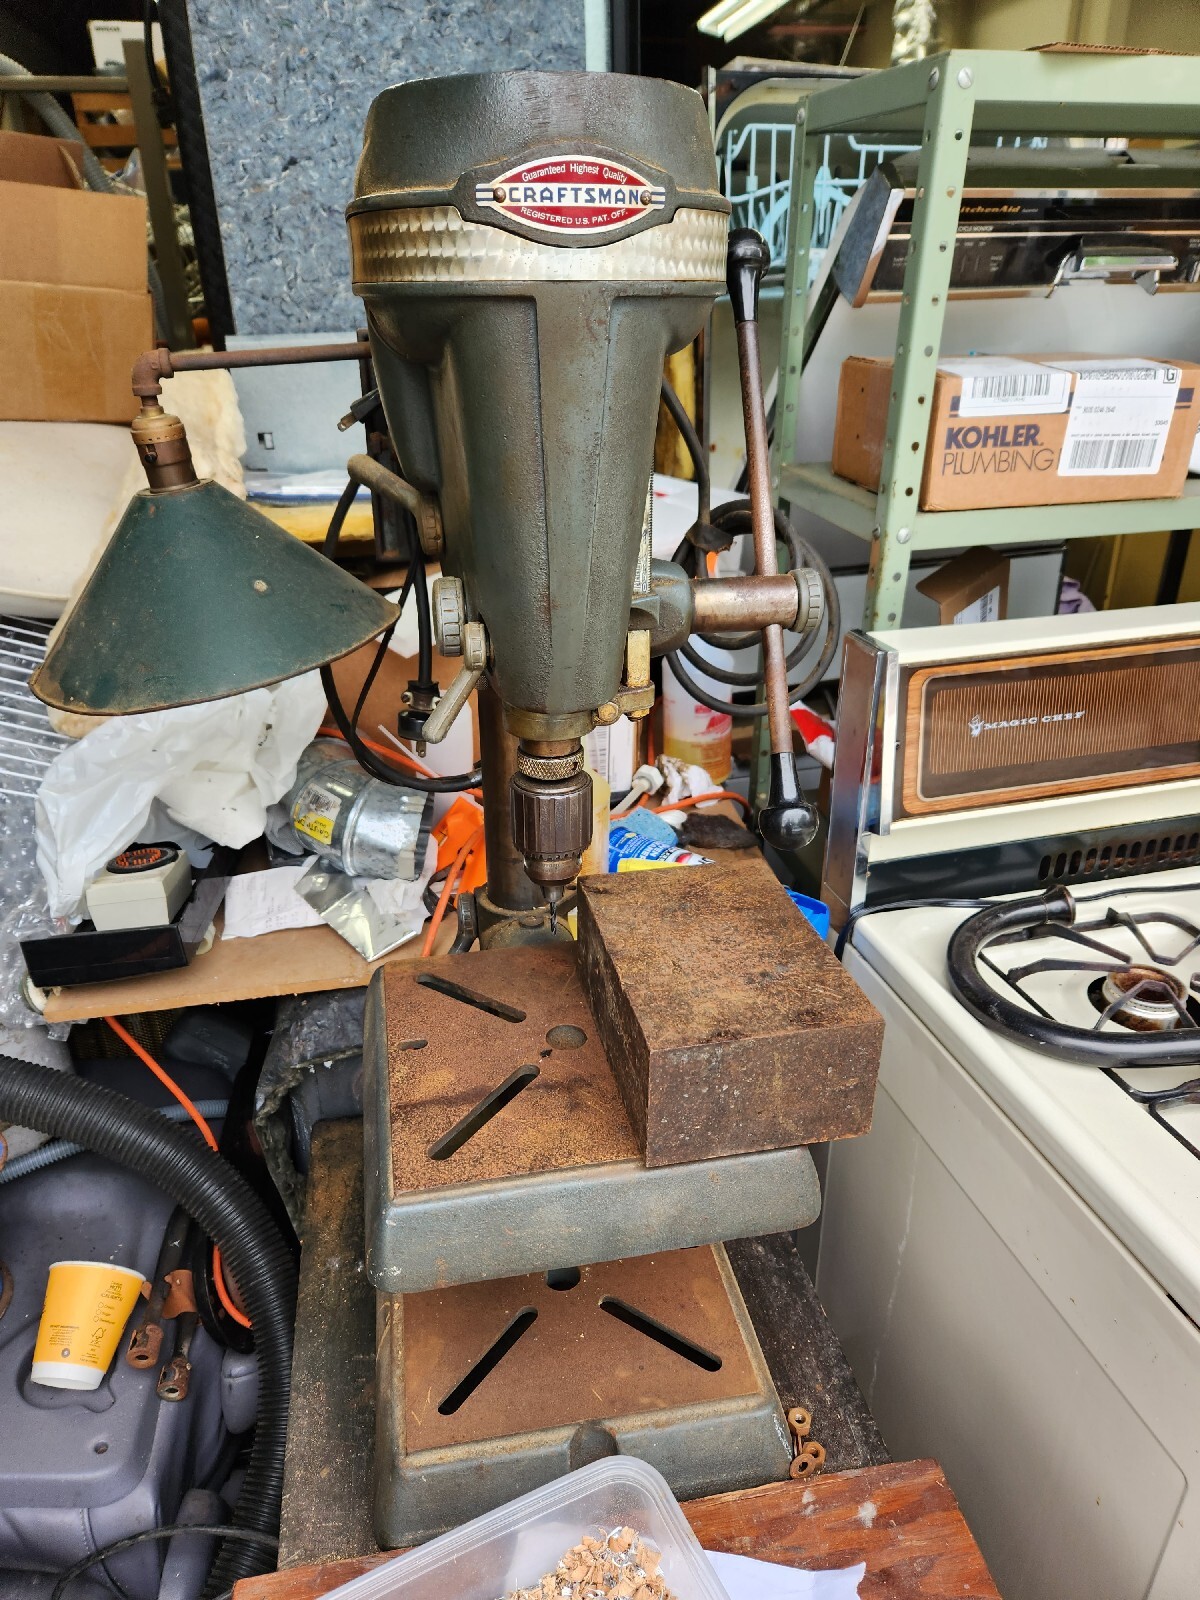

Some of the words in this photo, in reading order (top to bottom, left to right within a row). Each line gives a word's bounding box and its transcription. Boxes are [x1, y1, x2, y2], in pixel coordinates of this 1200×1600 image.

[522, 163, 566, 182] Guaranteed
[570, 163, 599, 175] Highest
[603, 168, 628, 184] Quality
[508, 186, 639, 205] CRAFTSMAN
[521, 206, 573, 224] REGISTERED
[575, 217, 590, 225] U.S.
[592, 216, 610, 224] PAT.
[611, 208, 628, 219] OFF.
[960, 205, 1021, 213] itchenAid
[944, 423, 1041, 450] KOHLER
[942, 448, 1054, 476] PLUMBING
[984, 717, 1038, 730] MAGIC
[1041, 710, 1085, 723] CHEF
